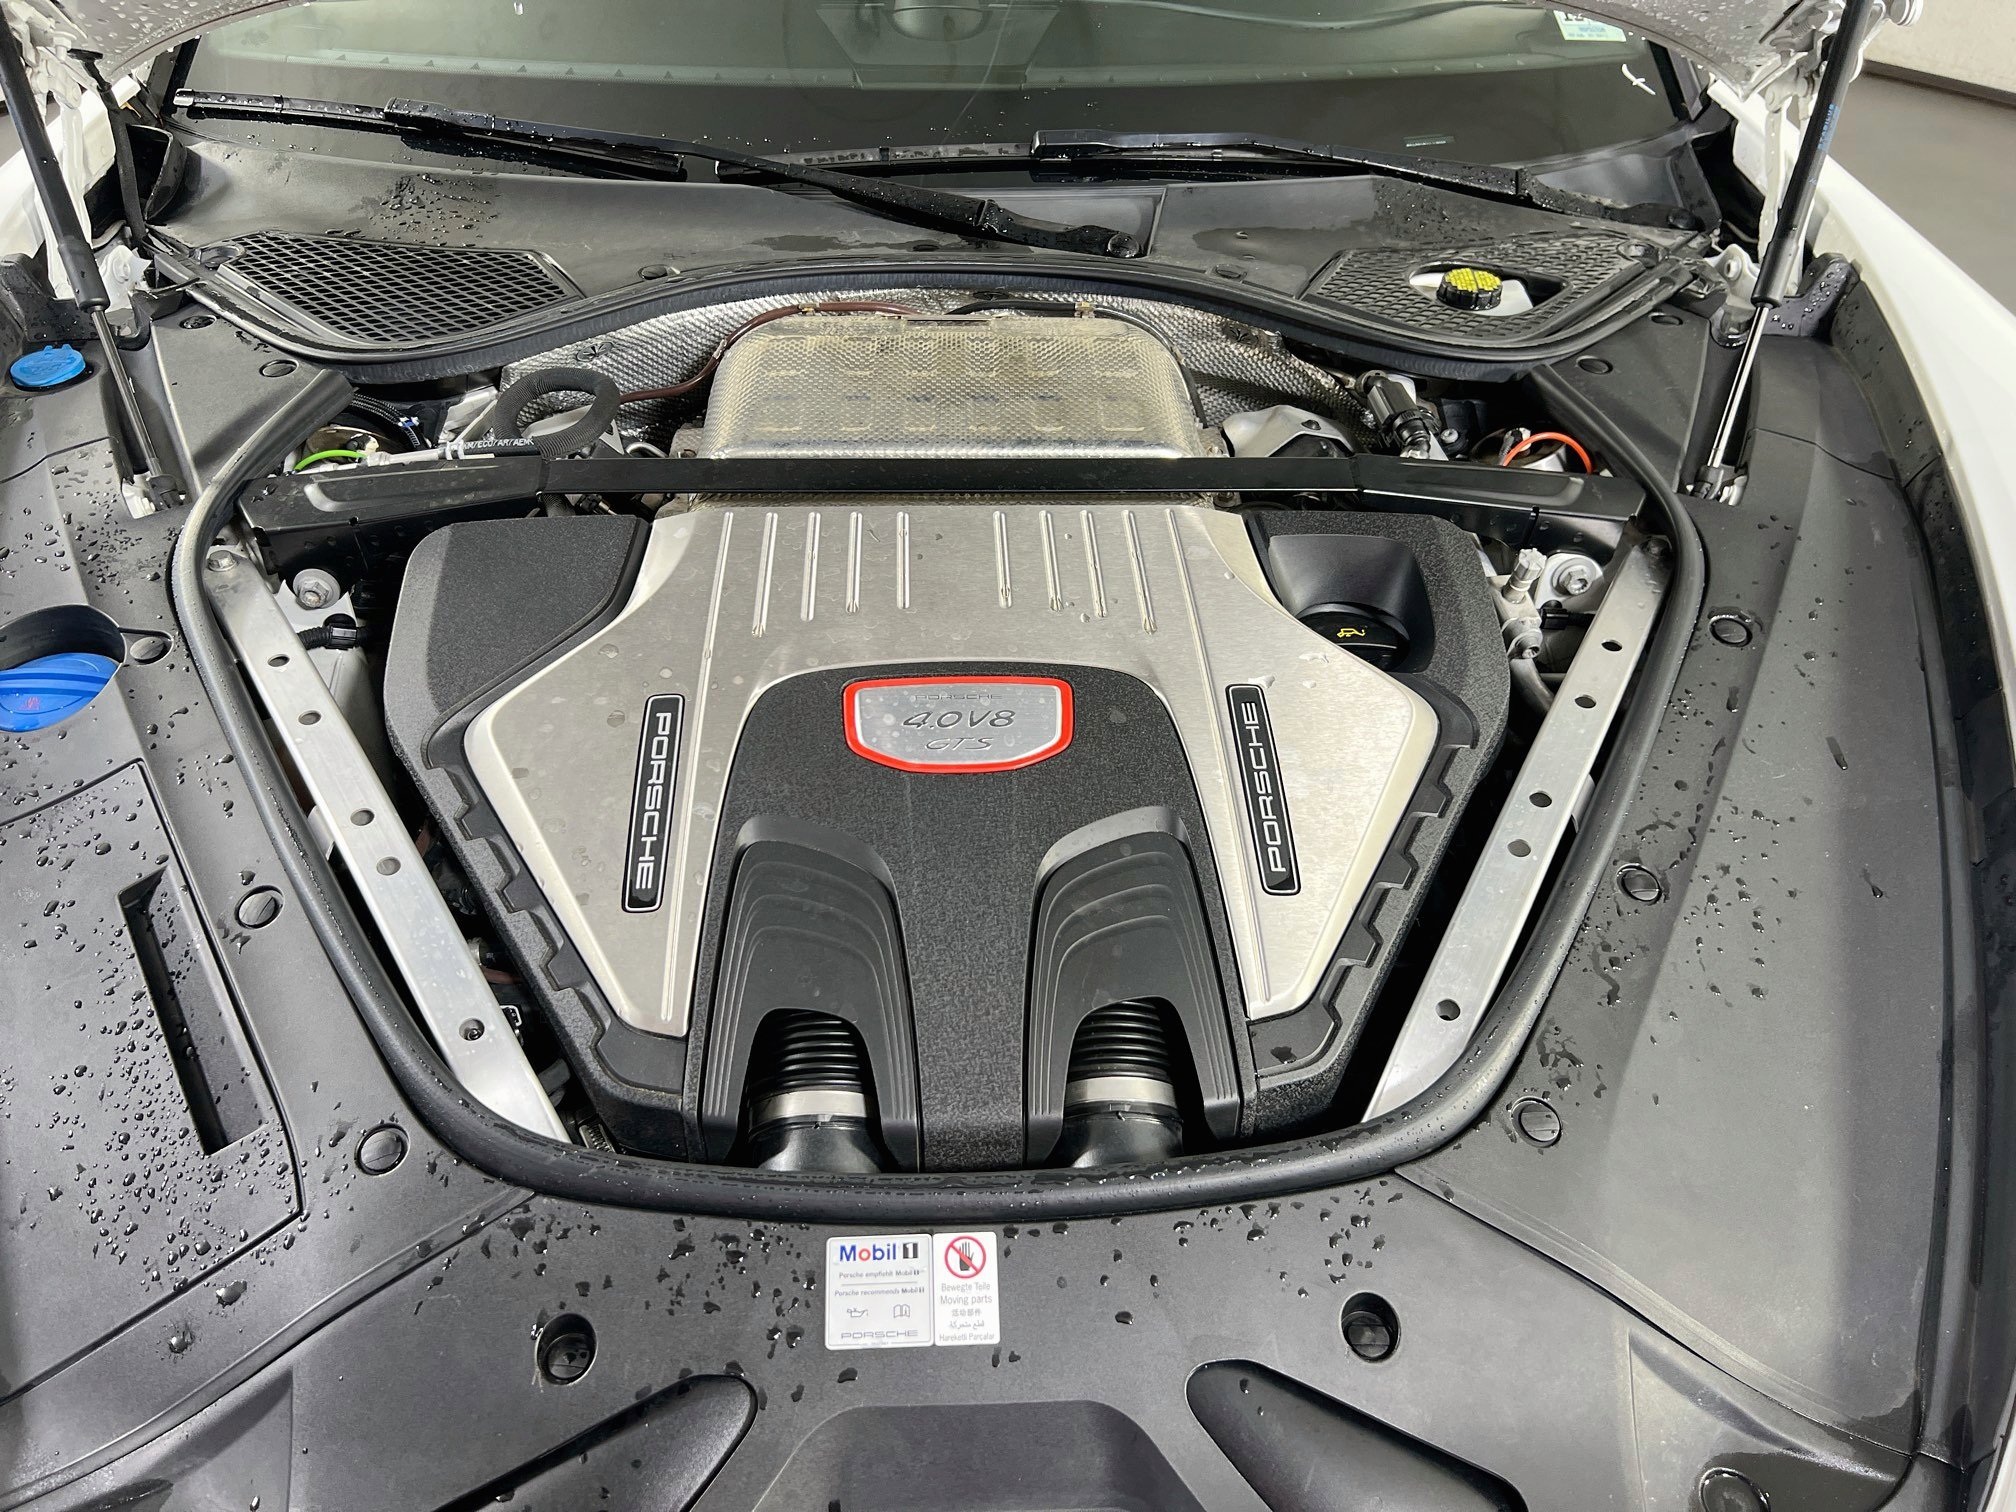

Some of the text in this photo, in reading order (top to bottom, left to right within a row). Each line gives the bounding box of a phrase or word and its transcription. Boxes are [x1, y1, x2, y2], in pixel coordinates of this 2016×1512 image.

[925, 737, 994, 750] GTS
[1241, 702, 1287, 872] PORSCHE
[635, 712, 672, 889] PORSCHE
[839, 1243, 896, 1262] Mobil
[834, 1289, 859, 1297] Porsche
[861, 1288, 900, 1296] recommends
[941, 1281, 991, 1292] Bewegte Teile
[940, 1295, 993, 1305] Moving parts
[841, 1330, 918, 1339] PORSCHE
